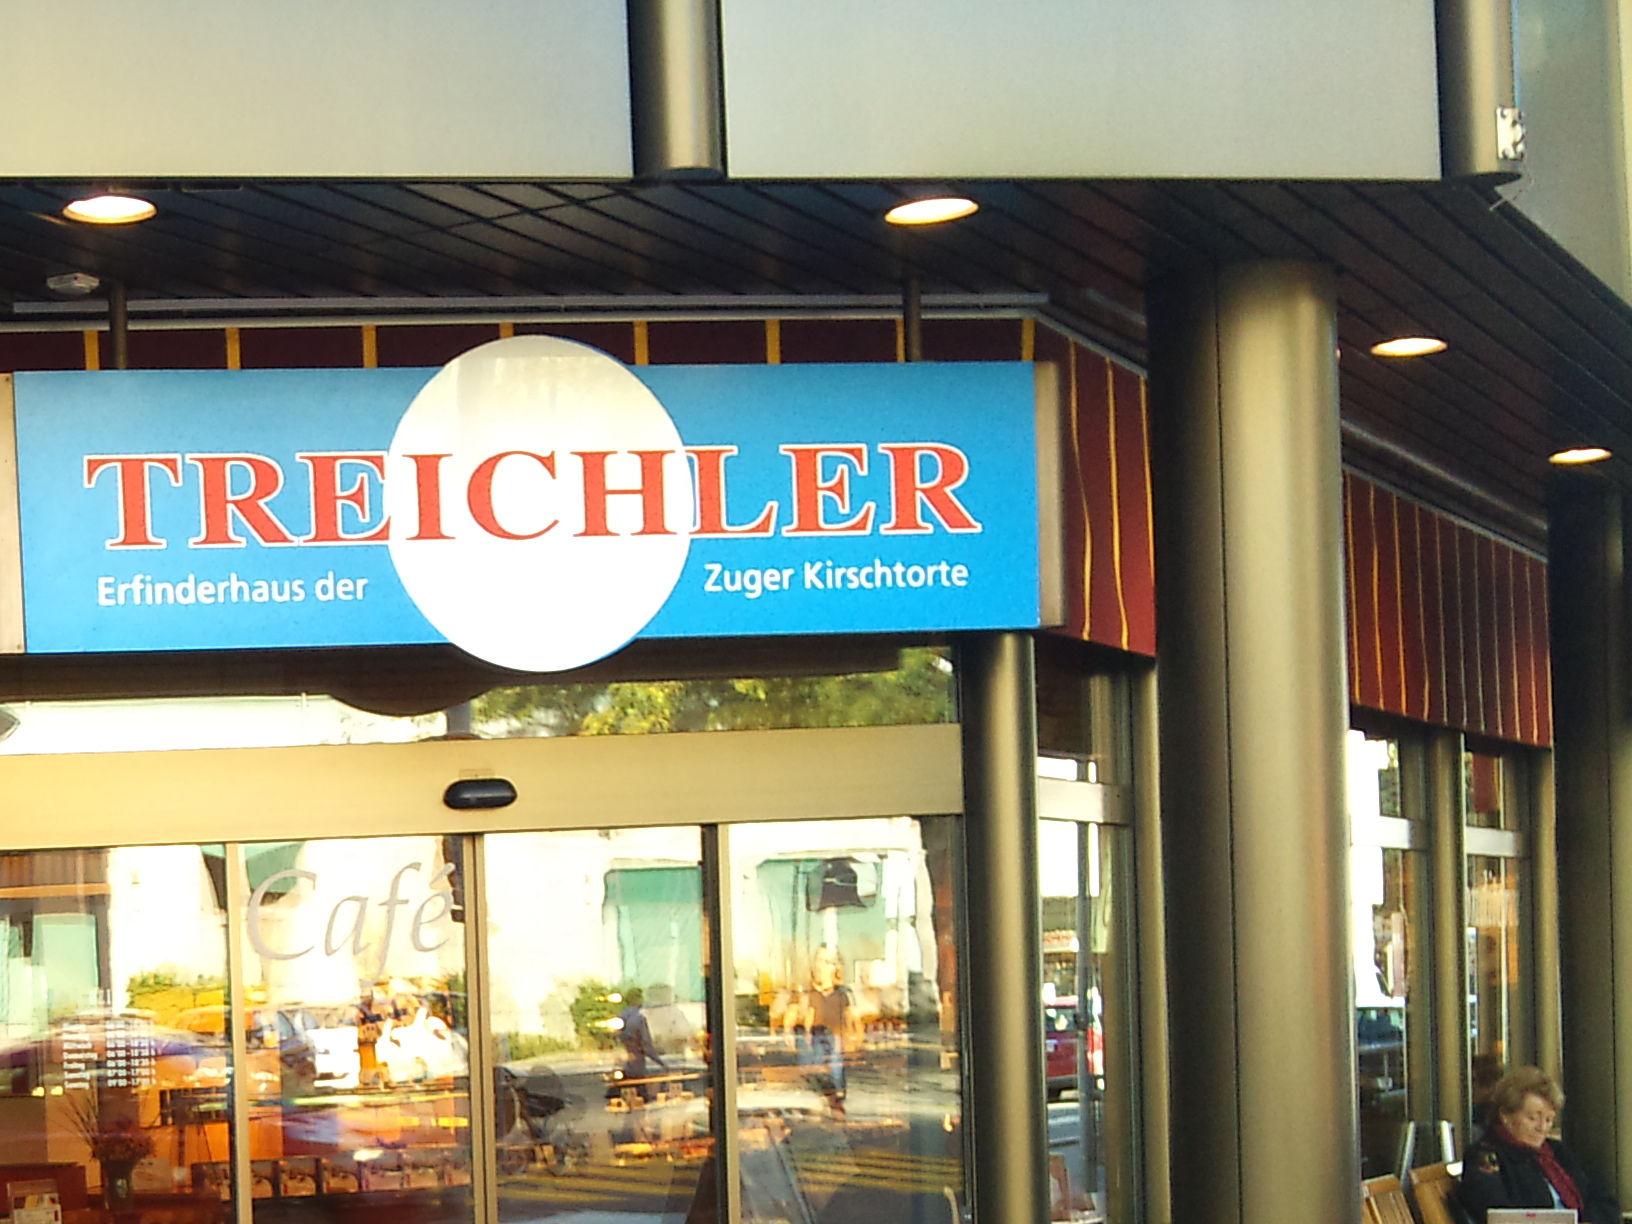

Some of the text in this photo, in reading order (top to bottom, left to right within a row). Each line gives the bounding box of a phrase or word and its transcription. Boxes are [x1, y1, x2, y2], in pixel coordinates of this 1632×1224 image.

[83, 442, 983, 550] TREICHLER
[97, 570, 368, 606] Erfinderhaus der
[703, 558, 969, 599] Zuger Kirschtorte
[246, 862, 456, 988] Café
